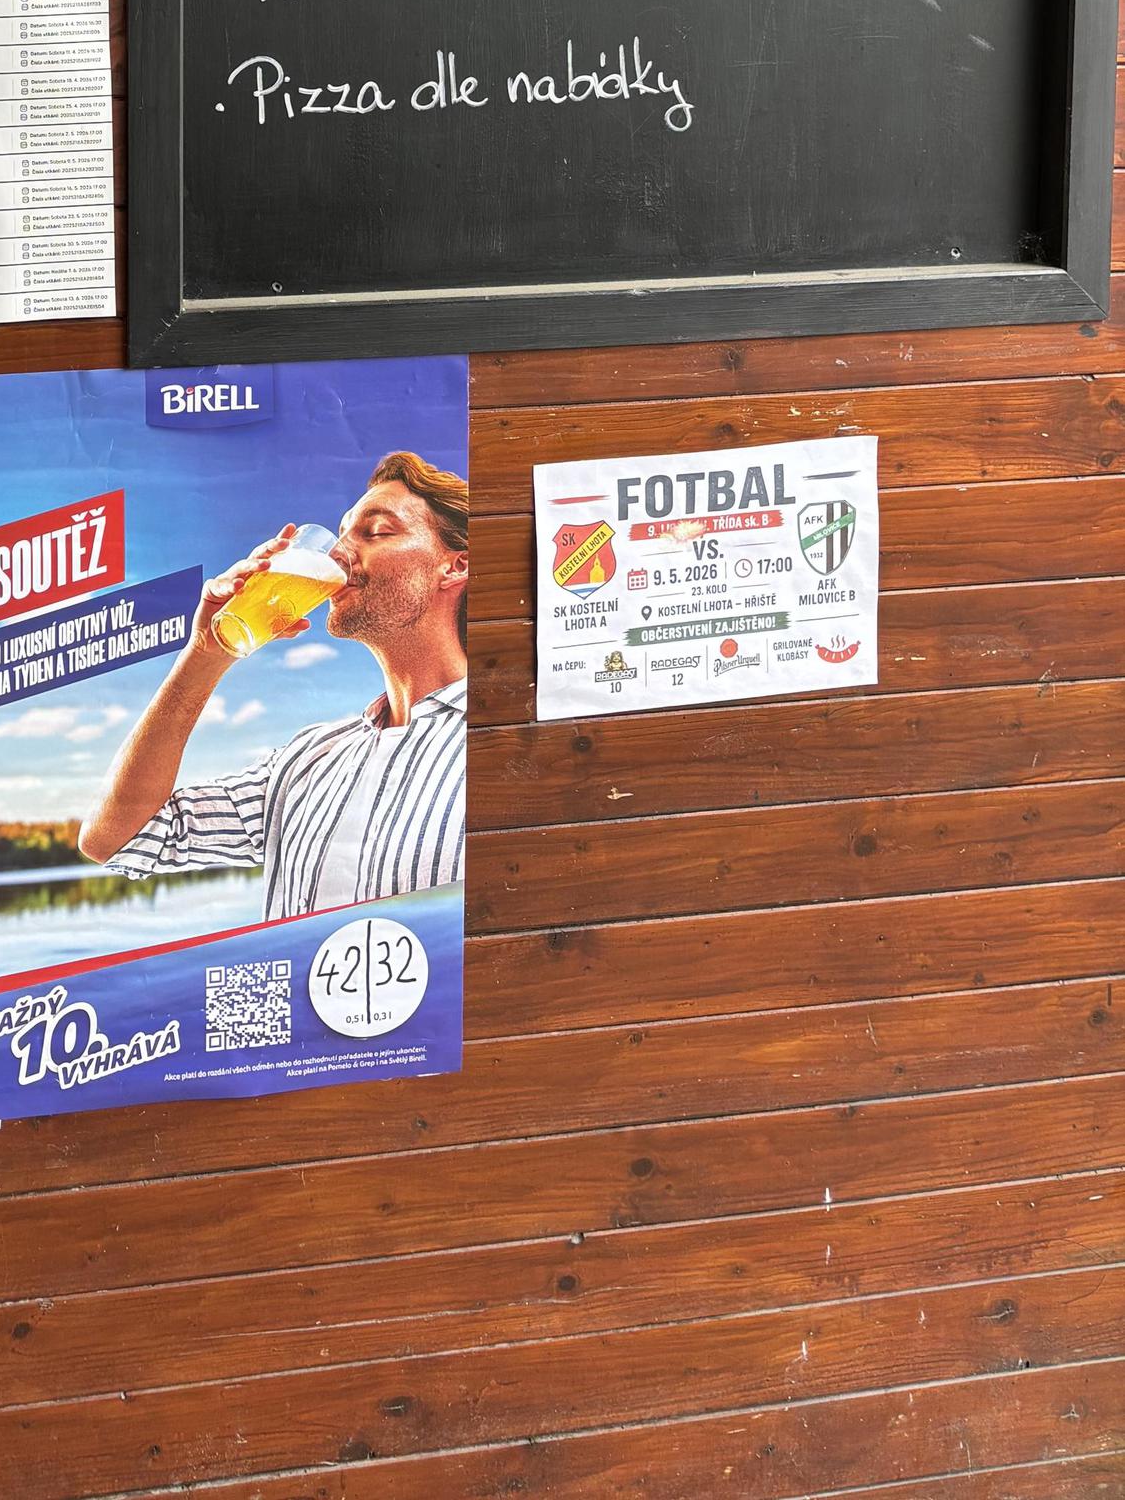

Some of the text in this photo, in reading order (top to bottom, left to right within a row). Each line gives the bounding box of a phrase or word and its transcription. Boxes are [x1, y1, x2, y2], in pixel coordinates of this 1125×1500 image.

[227, 36, 694, 132] Pizza dle nabídky
[617, 464, 796, 521] FOTBAL
[693, 539, 724, 561] VS.
[654, 557, 793, 586] 9. 5. 2026 17:00
[691, 583, 727, 596] 23. KOLO
[817, 578, 837, 591] AFK
[554, 598, 619, 618] SK KOSTELNÍ
[658, 593, 777, 618] KOSTELNÍ LHOTA HŘIŠTĚ
[798, 590, 856, 606] MILOVICE B
[3, 622, 57, 664] LUXUSNÍ
[59, 605, 108, 647] OBYTNÝ
[111, 599, 135, 631] VŮZ
[565, 617, 607, 631] LHOTA A
[641, 613, 776, 642] OBČERSTVENÍ ZAJIŠTĚNO!
[13, 654, 53, 691] TÝDEN
[57, 652, 64, 677] A
[67, 640, 105, 673] TISÍCE
[108, 623, 158, 661] DALŠÍCH
[161, 615, 185, 643] CEN
[773, 639, 813, 651] GRILOVANÉ
[777, 650, 809, 662] KLOBÁSY
[650, 656, 701, 669] RADEGAST
[315, 935, 418, 996] 42 32
[12, 1002, 108, 1086] 10.
[57, 1019, 180, 1089] VYHRÁVÁ
